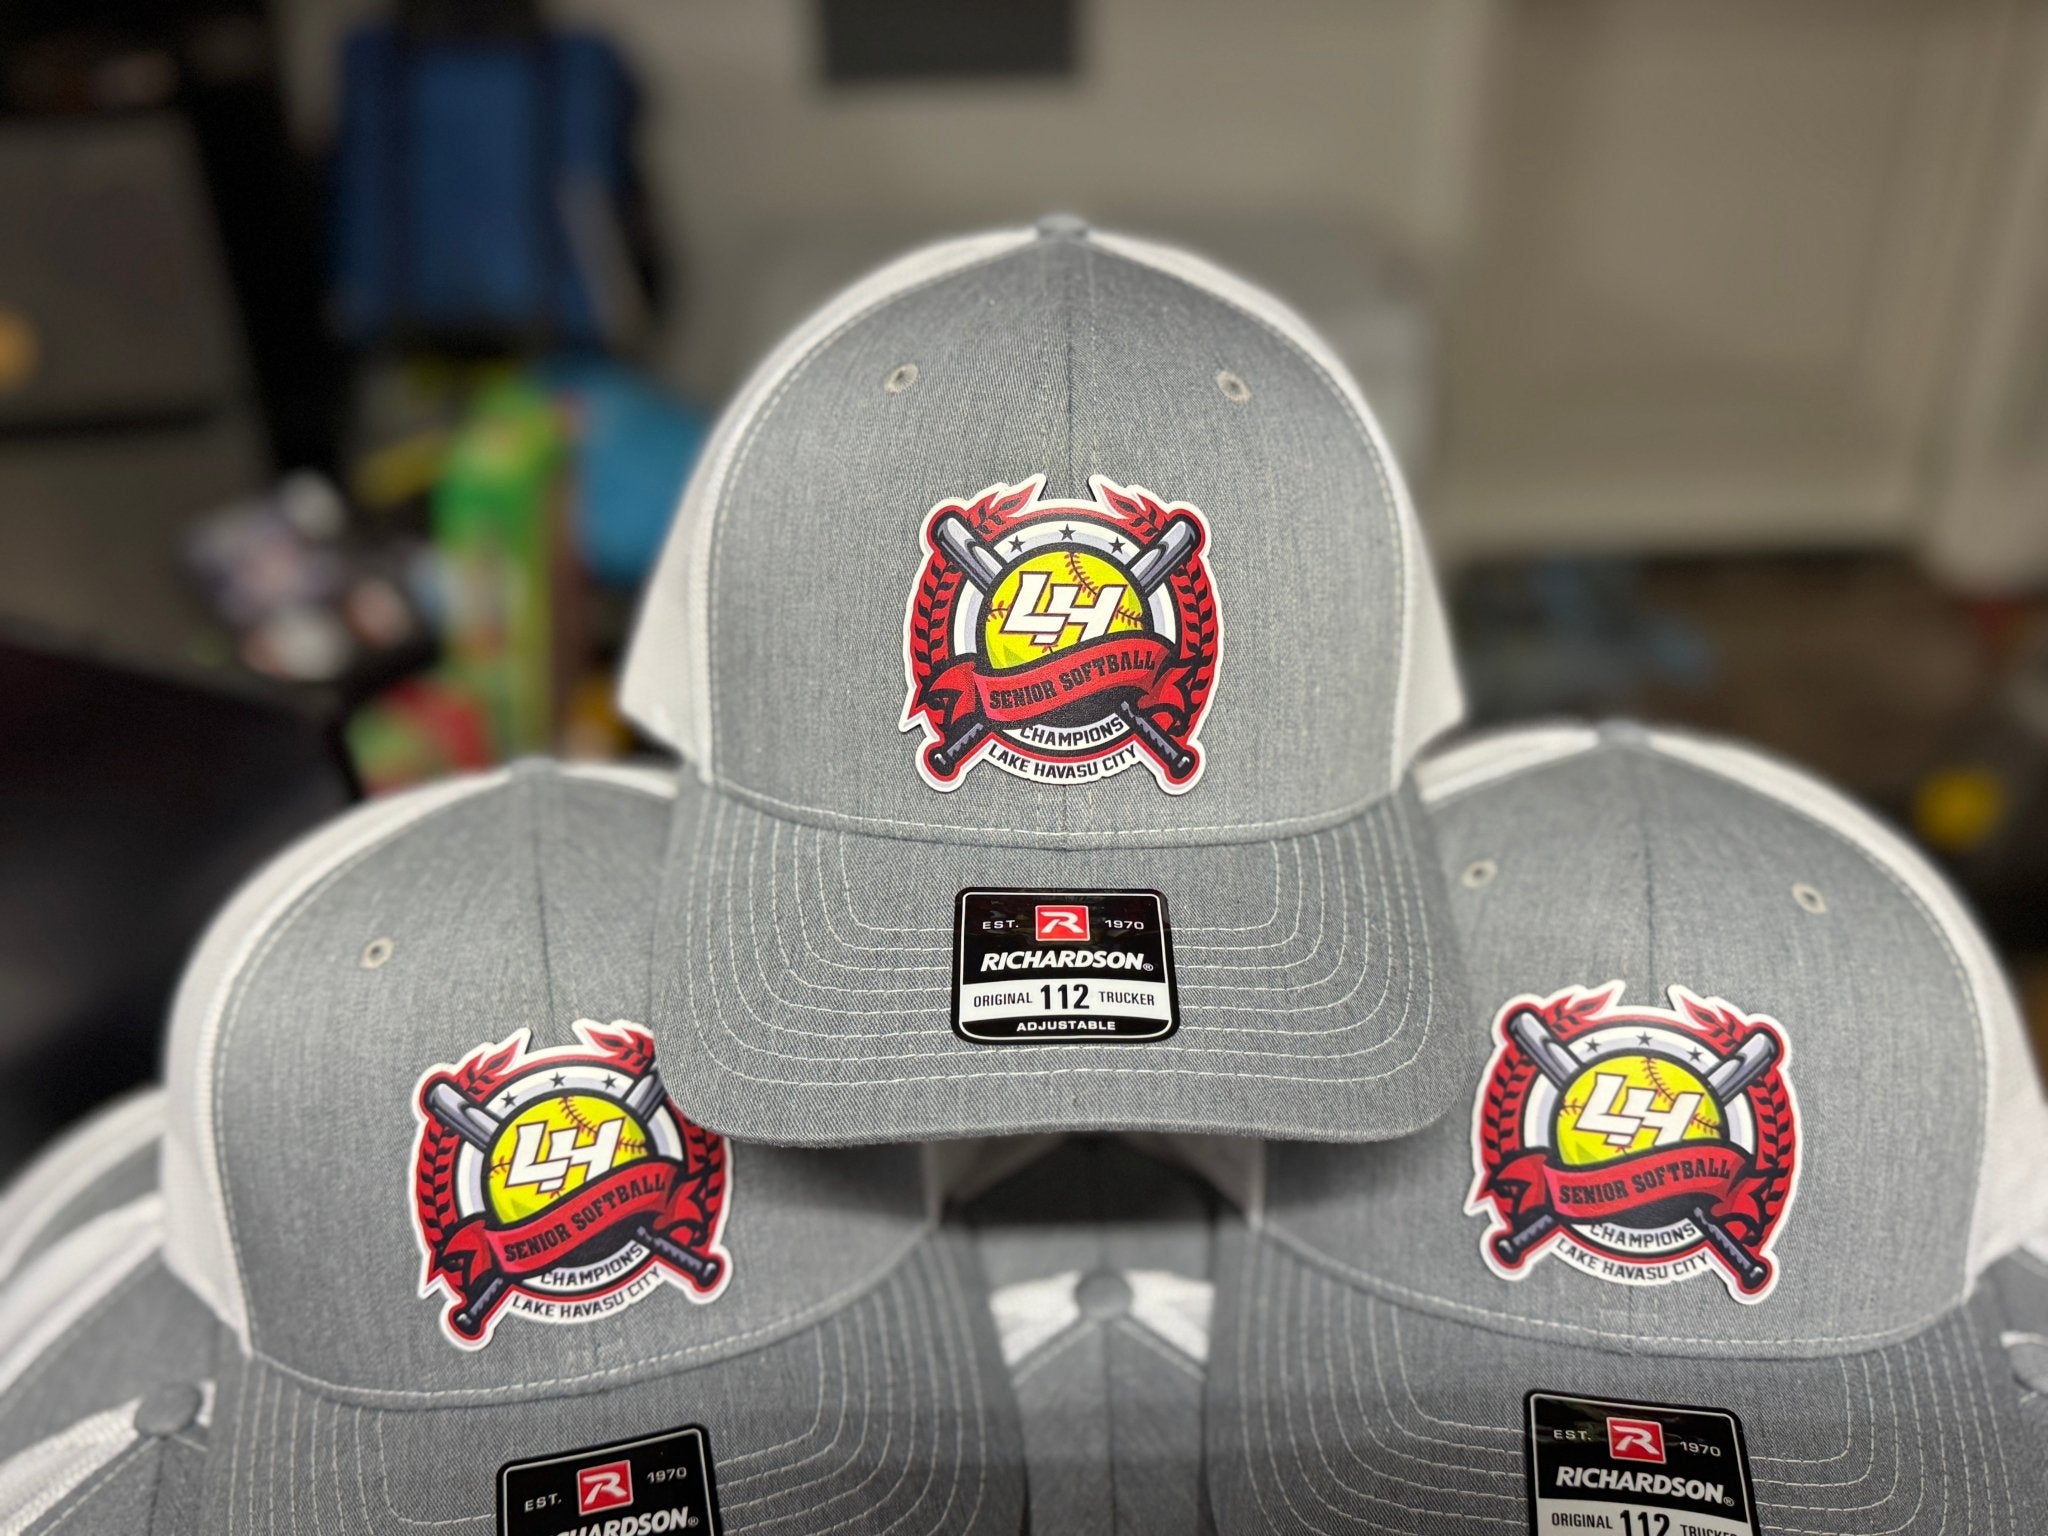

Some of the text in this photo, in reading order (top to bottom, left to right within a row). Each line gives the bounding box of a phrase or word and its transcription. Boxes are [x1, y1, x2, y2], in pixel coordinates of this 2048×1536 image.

[989, 651, 1155, 709] SENIOR SOFTBALL
[1019, 718, 1124, 747] CHAMPIONS
[987, 743, 1137, 779] LAKE HAVASU CITY
[982, 919, 1019, 930] EST.
[1104, 919, 1144, 930] 1970
[973, 984, 1155, 1010] ORIGINAL 112 TRUCKER
[1016, 1020, 1116, 1032] ADJUSTABLE
[1559, 1157, 1730, 1205] SENIOR SOFTBALL
[504, 1173, 666, 1262] SENIOR SOFTBALL
[1589, 1222, 1696, 1248] CHAMPIONS
[540, 1244, 644, 1286] CHAMPIONS
[1556, 1238, 1710, 1280] LAKE HAVASU CITY
[512, 1269, 662, 1318] LAKE HAVASU CITY
[1553, 1429, 1592, 1441] EST.
[1680, 1441, 1721, 1458] 1970
[646, 1467, 688, 1484] 1970
[524, 1492, 562, 1512] EST.
[556, 1507, 688, 1536] ARDSON
[1551, 1509, 1737, 1536] ORIGINAL 112 TRUC
